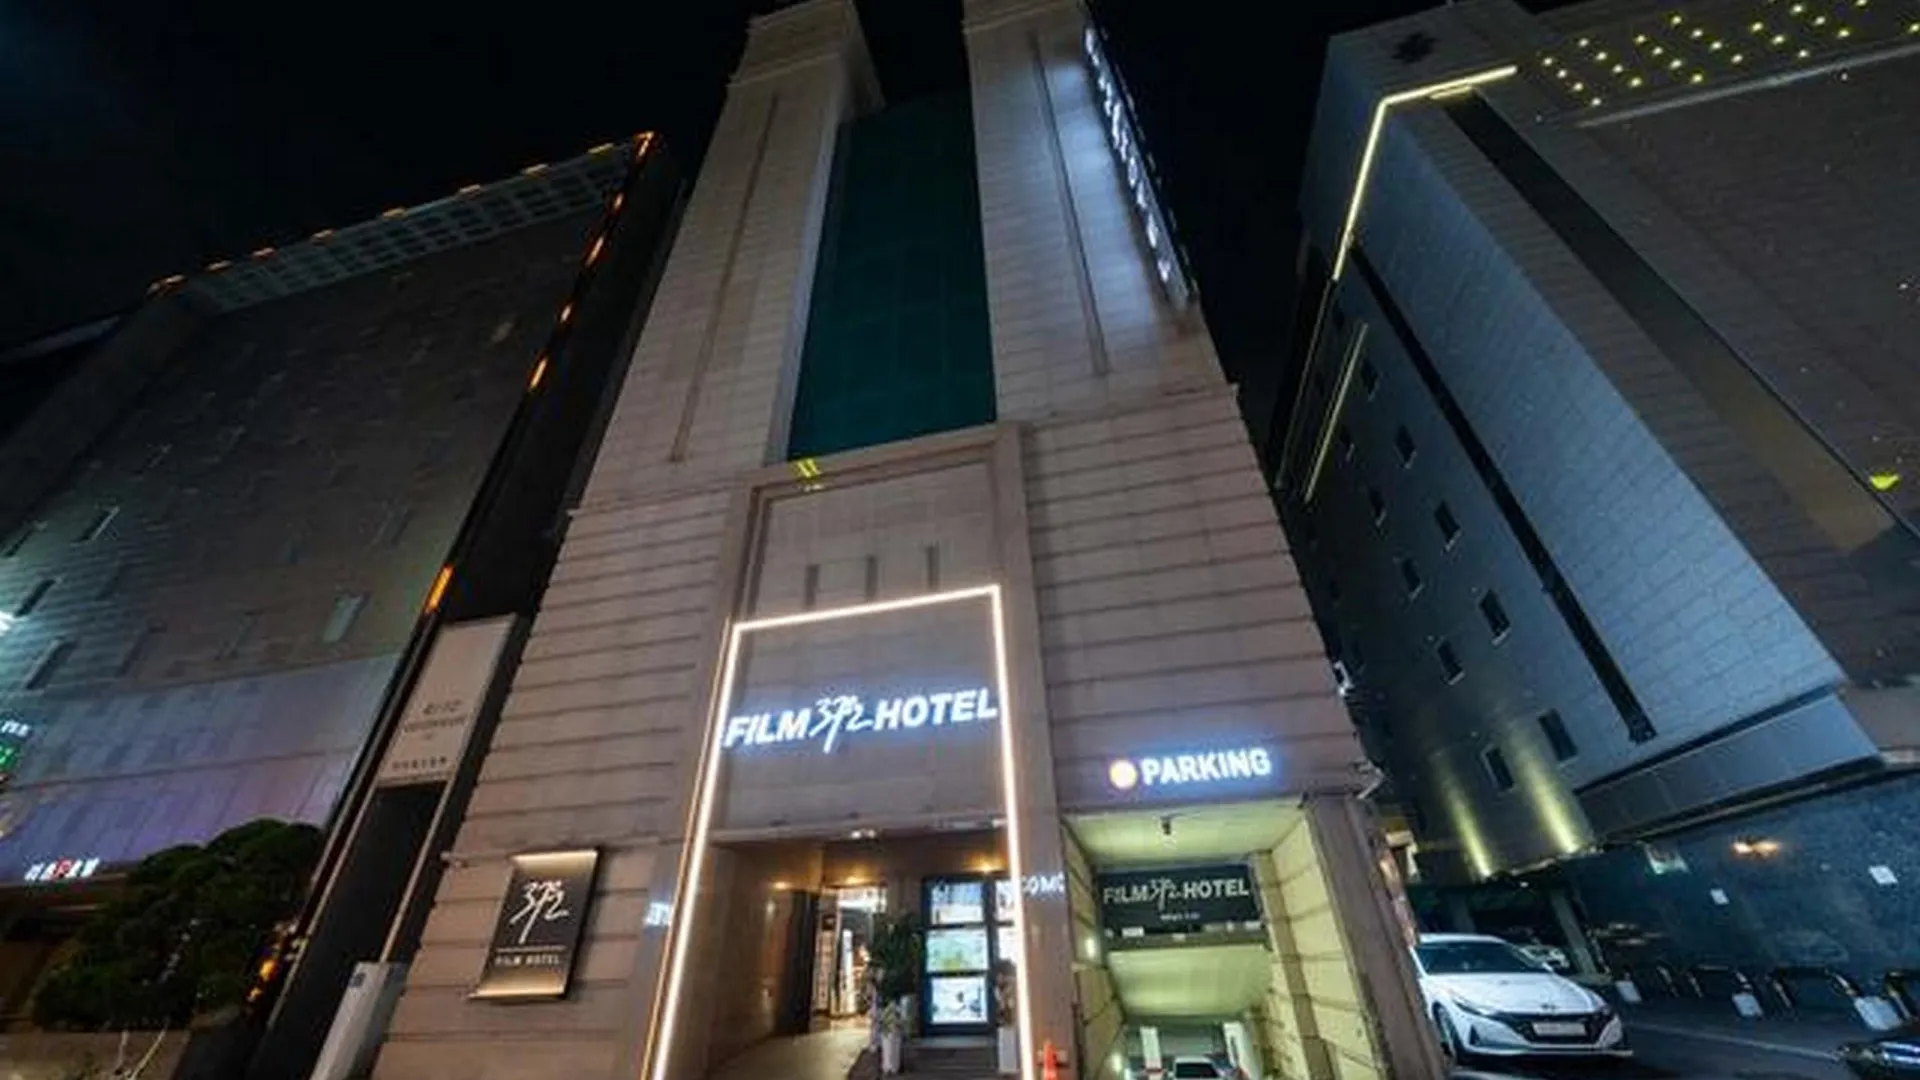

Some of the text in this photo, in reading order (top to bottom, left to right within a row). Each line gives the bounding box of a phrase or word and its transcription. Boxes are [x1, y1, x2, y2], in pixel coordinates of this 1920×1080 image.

[724, 707, 811, 748] FILM
[873, 687, 998, 731] HOTEL
[1140, 747, 1272, 786] PARKING
[1103, 884, 1149, 904] FILM
[1183, 878, 1250, 899] HOTEL
[525, 953, 561, 965] HOTEL
